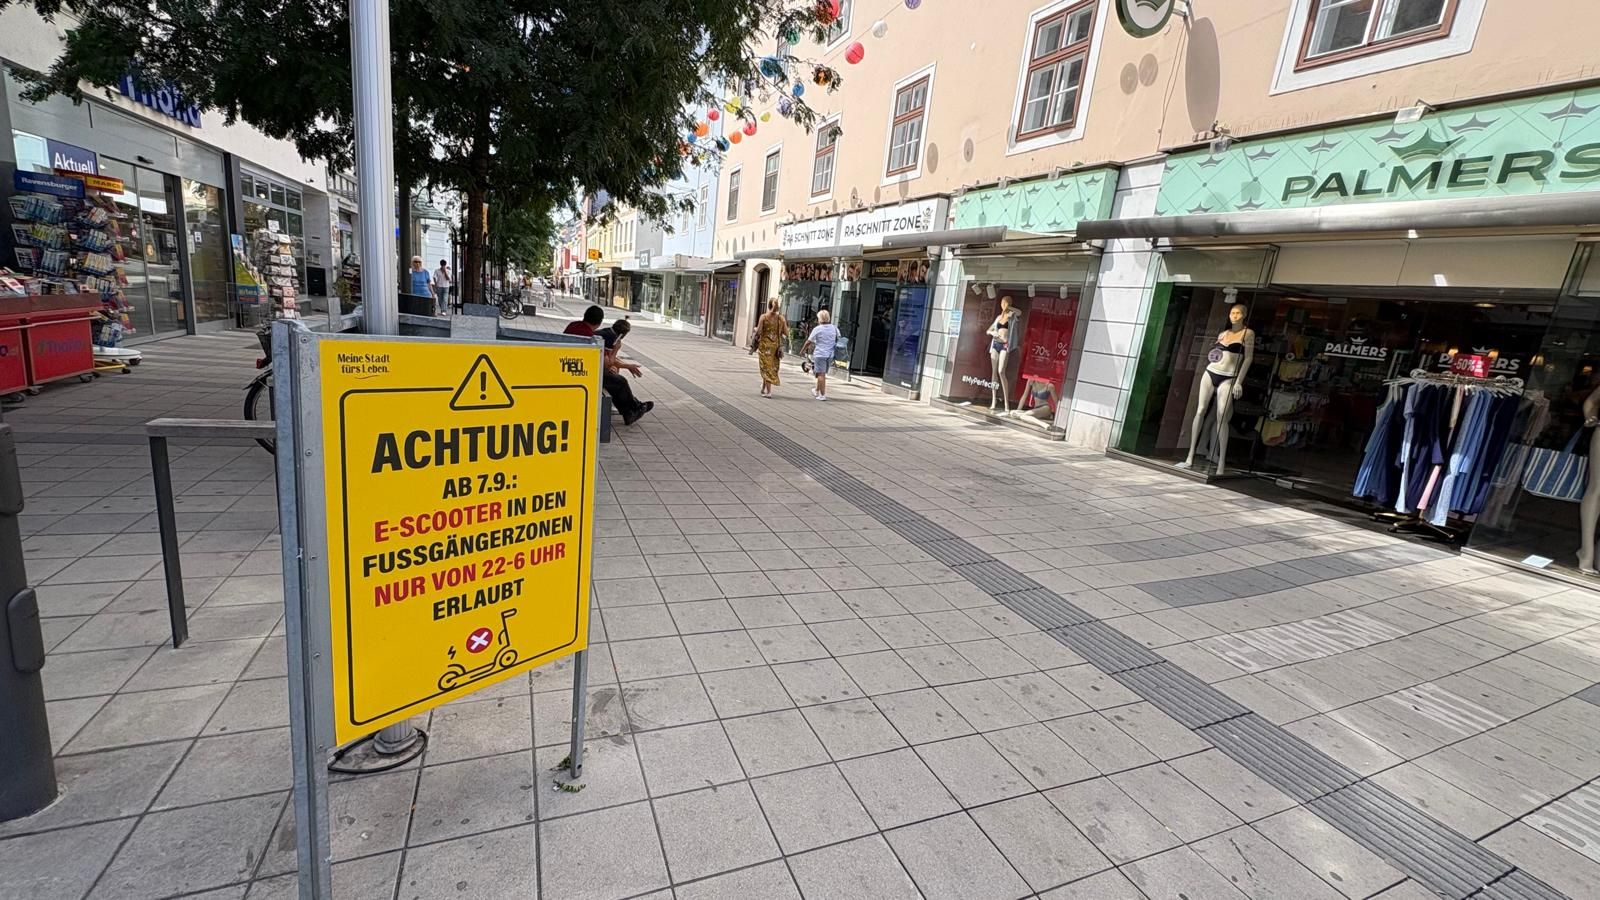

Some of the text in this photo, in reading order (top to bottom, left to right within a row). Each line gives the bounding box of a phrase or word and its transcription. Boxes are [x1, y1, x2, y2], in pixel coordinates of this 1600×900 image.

[54, 152, 94, 174] Aktuell
[1281, 141, 1600, 202] PALMERS
[21, 177, 78, 191] Ravensburger
[817, 227, 834, 240] ZONE
[844, 214, 922, 237] RA SCHNITT ZONE
[337, 353, 390, 363] Meine Stadt
[1324, 342, 1388, 358] PALMERS
[341, 364, 390, 374] fürs Leben.
[371, 420, 569, 473] ACHTUNG!
[442, 472, 517, 499] AB 7.9.:
[374, 490, 566, 543] E-SCOOTER IN DEN
[363, 515, 573, 577] FUSSGÄNGERZONEN
[374, 542, 565, 607] NUR VON 22-6 UHR
[433, 578, 525, 621] ERLAUBT
